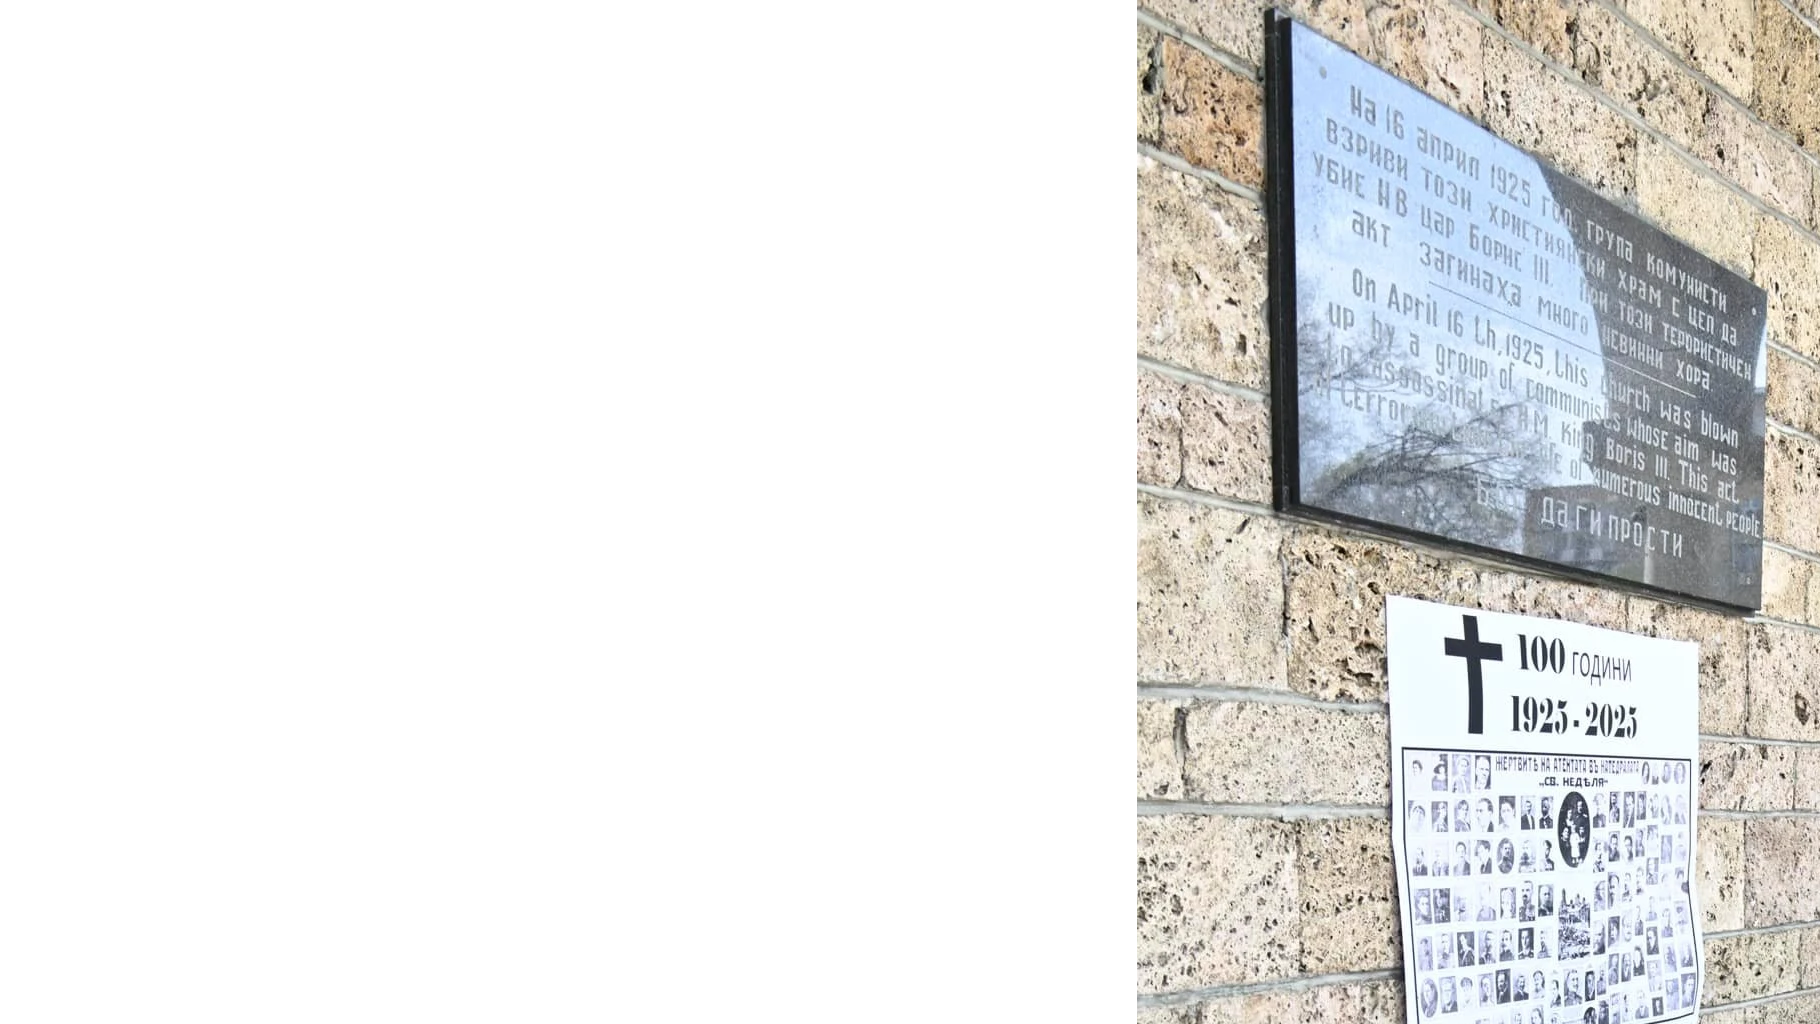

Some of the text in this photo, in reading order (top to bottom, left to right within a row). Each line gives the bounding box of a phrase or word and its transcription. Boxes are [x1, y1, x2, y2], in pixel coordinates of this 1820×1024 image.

[1326, 117, 1408, 181] взриви
[1421, 166, 1472, 212] този
[1618, 268, 1662, 308] храм
[1721, 323, 1737, 346] да
[1352, 209, 1391, 248] акт
[1419, 241, 1522, 308] загинаха
[1538, 296, 1589, 336] много
[1386, 104, 1404, 140] 16
[1491, 164, 1530, 208] 1925
[1587, 219, 1633, 263] група
[1647, 252, 1728, 313] комунисти
[1352, 268, 1376, 303] On
[1387, 282, 1438, 328] April
[1448, 309, 1464, 338] 16
[1555, 348, 1588, 388] this
[1660, 400, 1692, 431] was
[1700, 410, 1739, 449] blown
[1421, 204, 1455, 239] цар
[1469, 223, 1522, 273] Борис
[1618, 299, 1653, 335] този
[1662, 321, 1751, 381] терористичен
[1328, 301, 1354, 331] up
[1372, 311, 1395, 351] by
[1410, 332, 1420, 358] a
[1435, 343, 1488, 382] group
[1500, 361, 1515, 393] of
[1626, 416, 1668, 451] whose
[1674, 433, 1699, 462] aim
[1712, 450, 1737, 476] was
[1561, 421, 1594, 463] King
[1606, 437, 1645, 472] Boris
[1678, 459, 1708, 493] This
[1718, 479, 1740, 505] act
[1576, 506, 1601, 537] ги
[1669, 485, 1723, 527] innocent
[1517, 633, 1565, 674] 100
